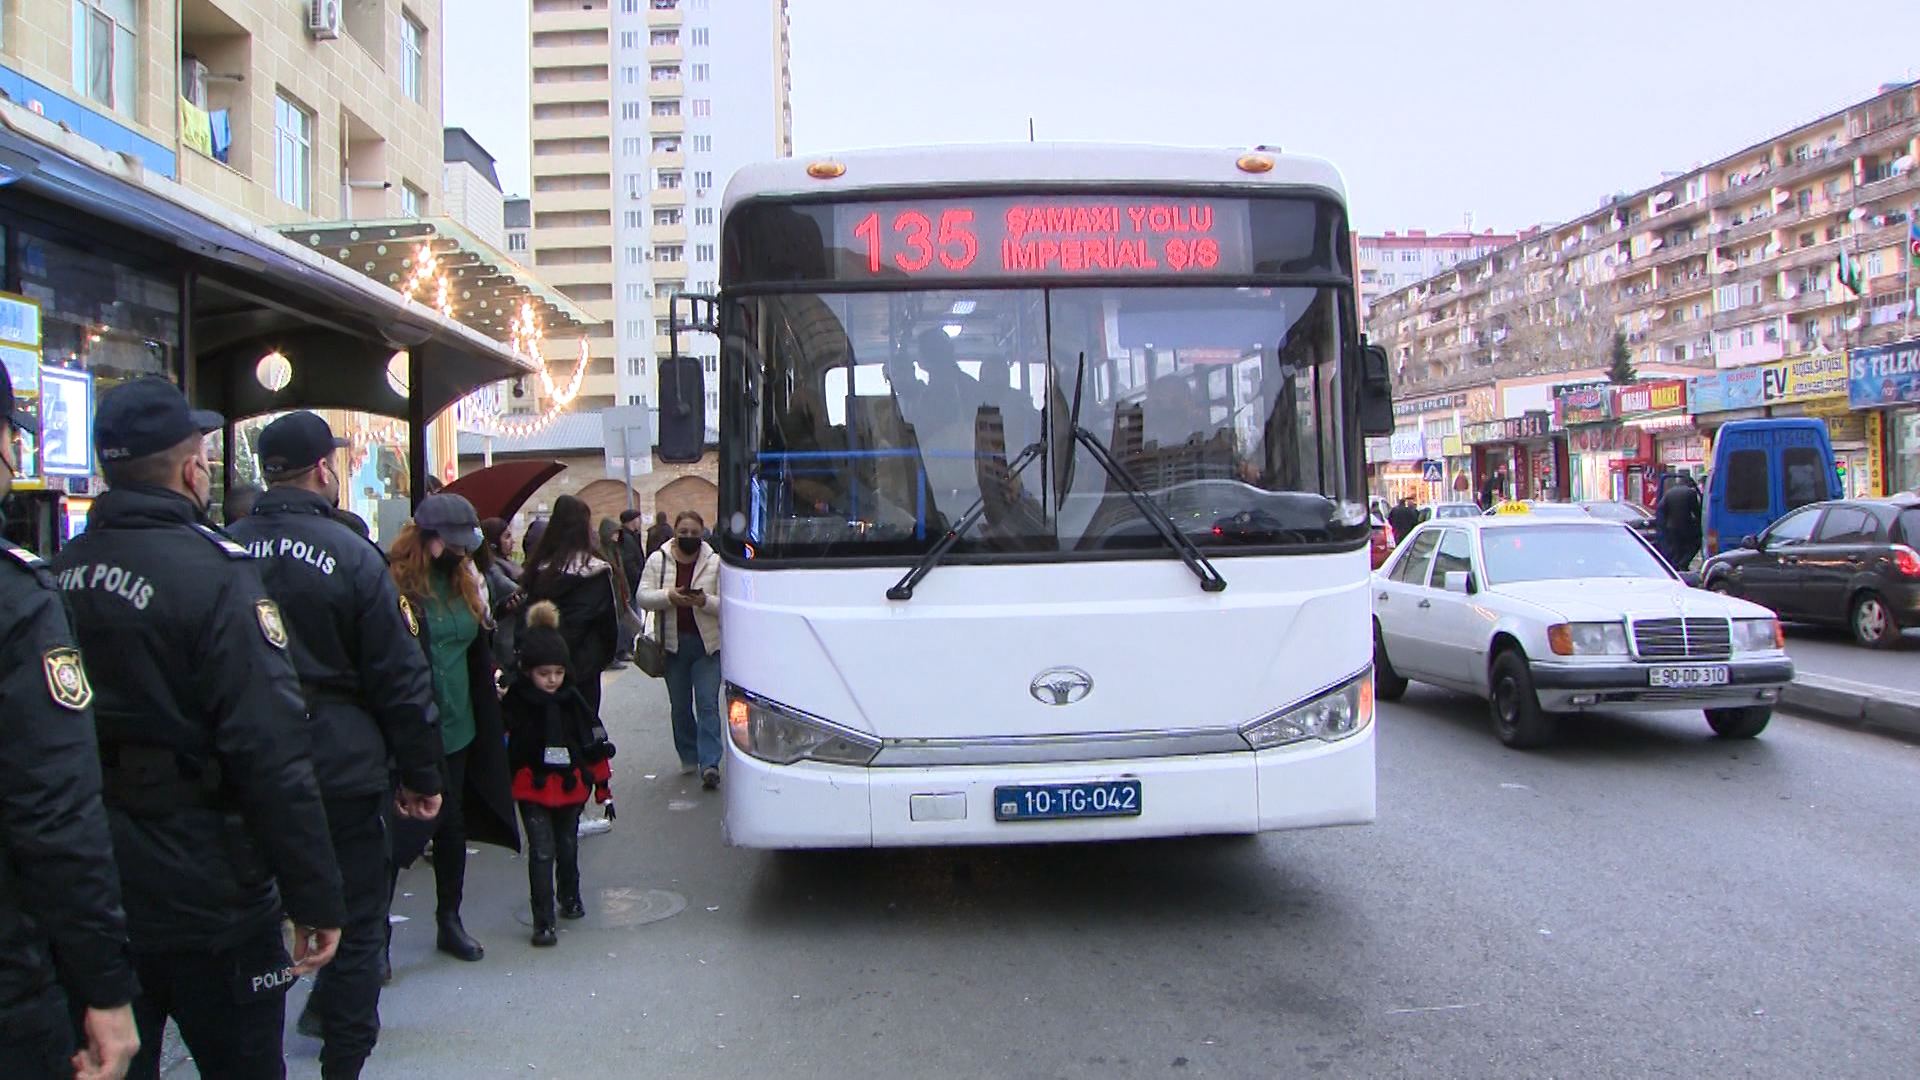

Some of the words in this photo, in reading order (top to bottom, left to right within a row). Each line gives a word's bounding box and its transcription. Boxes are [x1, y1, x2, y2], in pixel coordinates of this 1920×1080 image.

[1128, 207, 1212, 232] YOLU
[855, 208, 977, 273] 135
[1762, 367, 1788, 401] EV
[90, 563, 154, 610] POLİS
